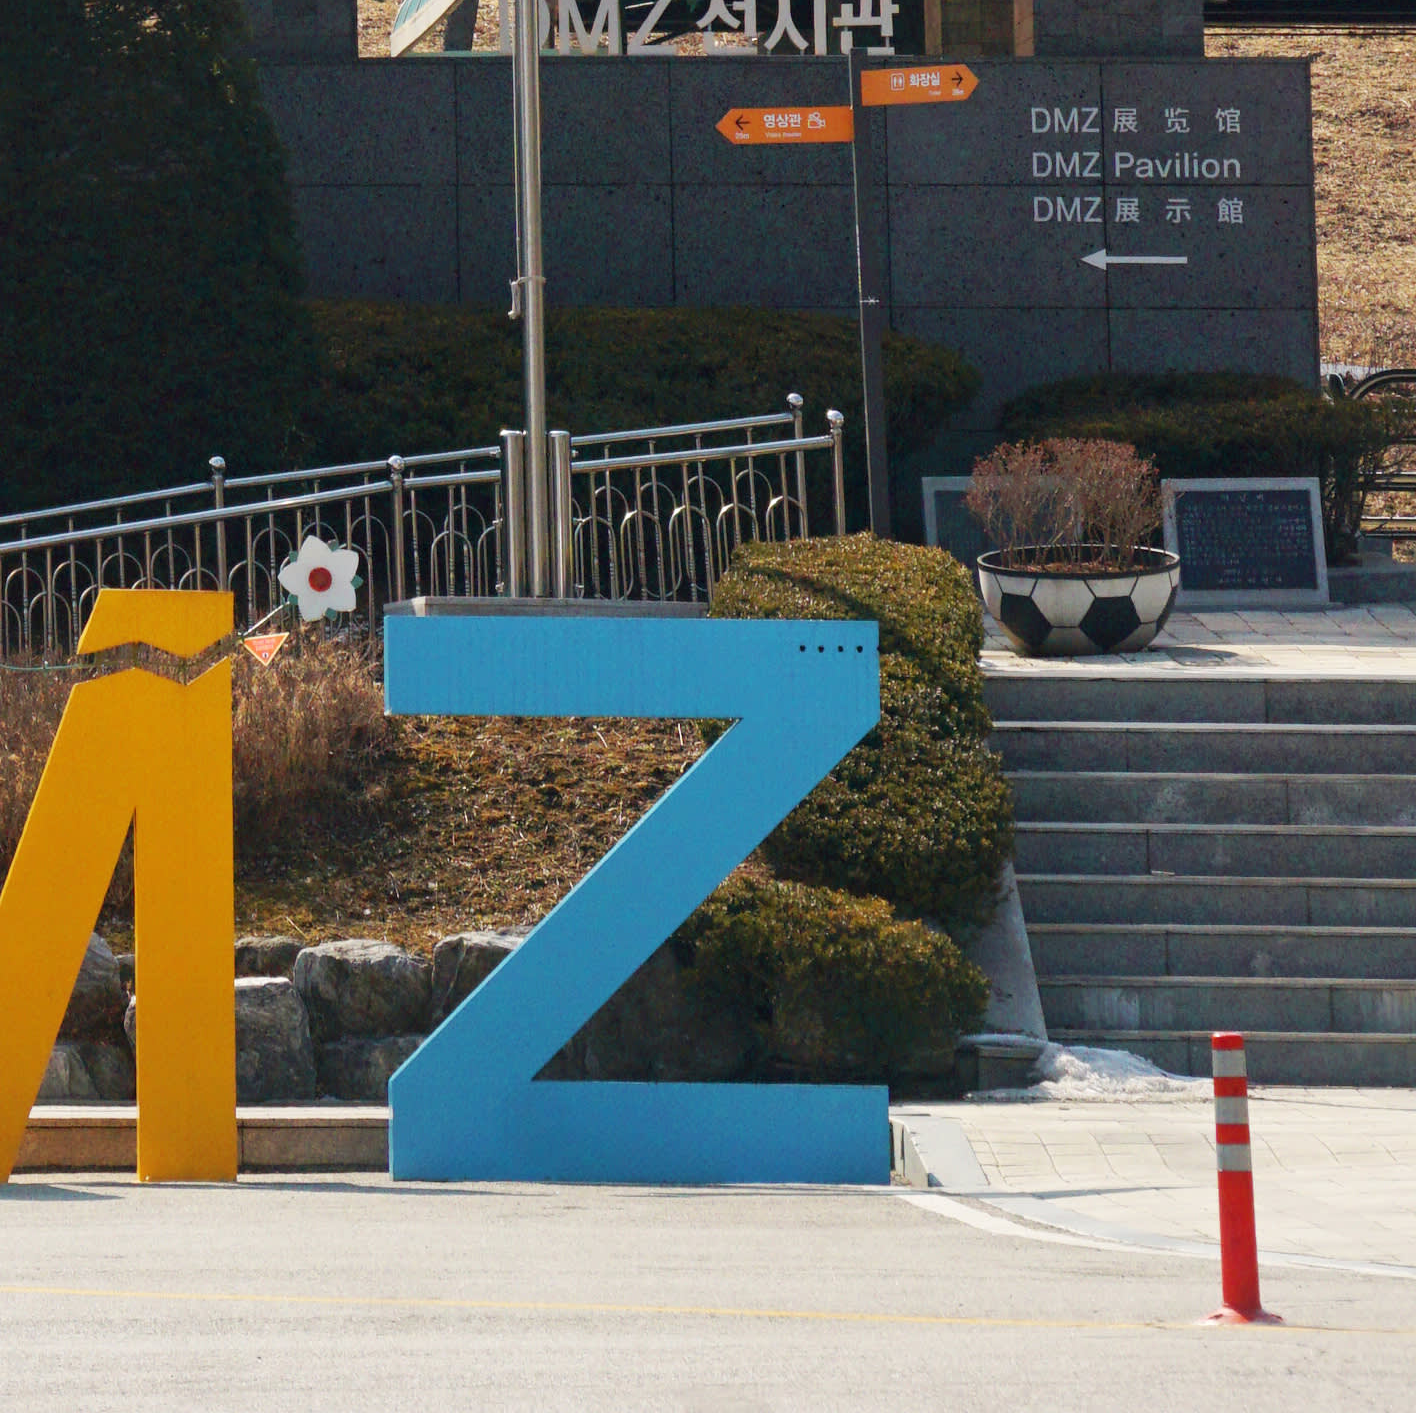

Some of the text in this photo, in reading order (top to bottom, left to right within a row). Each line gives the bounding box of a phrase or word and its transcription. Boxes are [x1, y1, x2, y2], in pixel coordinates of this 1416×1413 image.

[909, 71, 941, 87] 화장실
[763, 113, 802, 129] 영상관
[1031, 107, 1241, 134] DMZ 展览馆
[1032, 151, 1241, 178] DMZ Pavilion
[1033, 197, 1243, 224] DMZ 展示館
